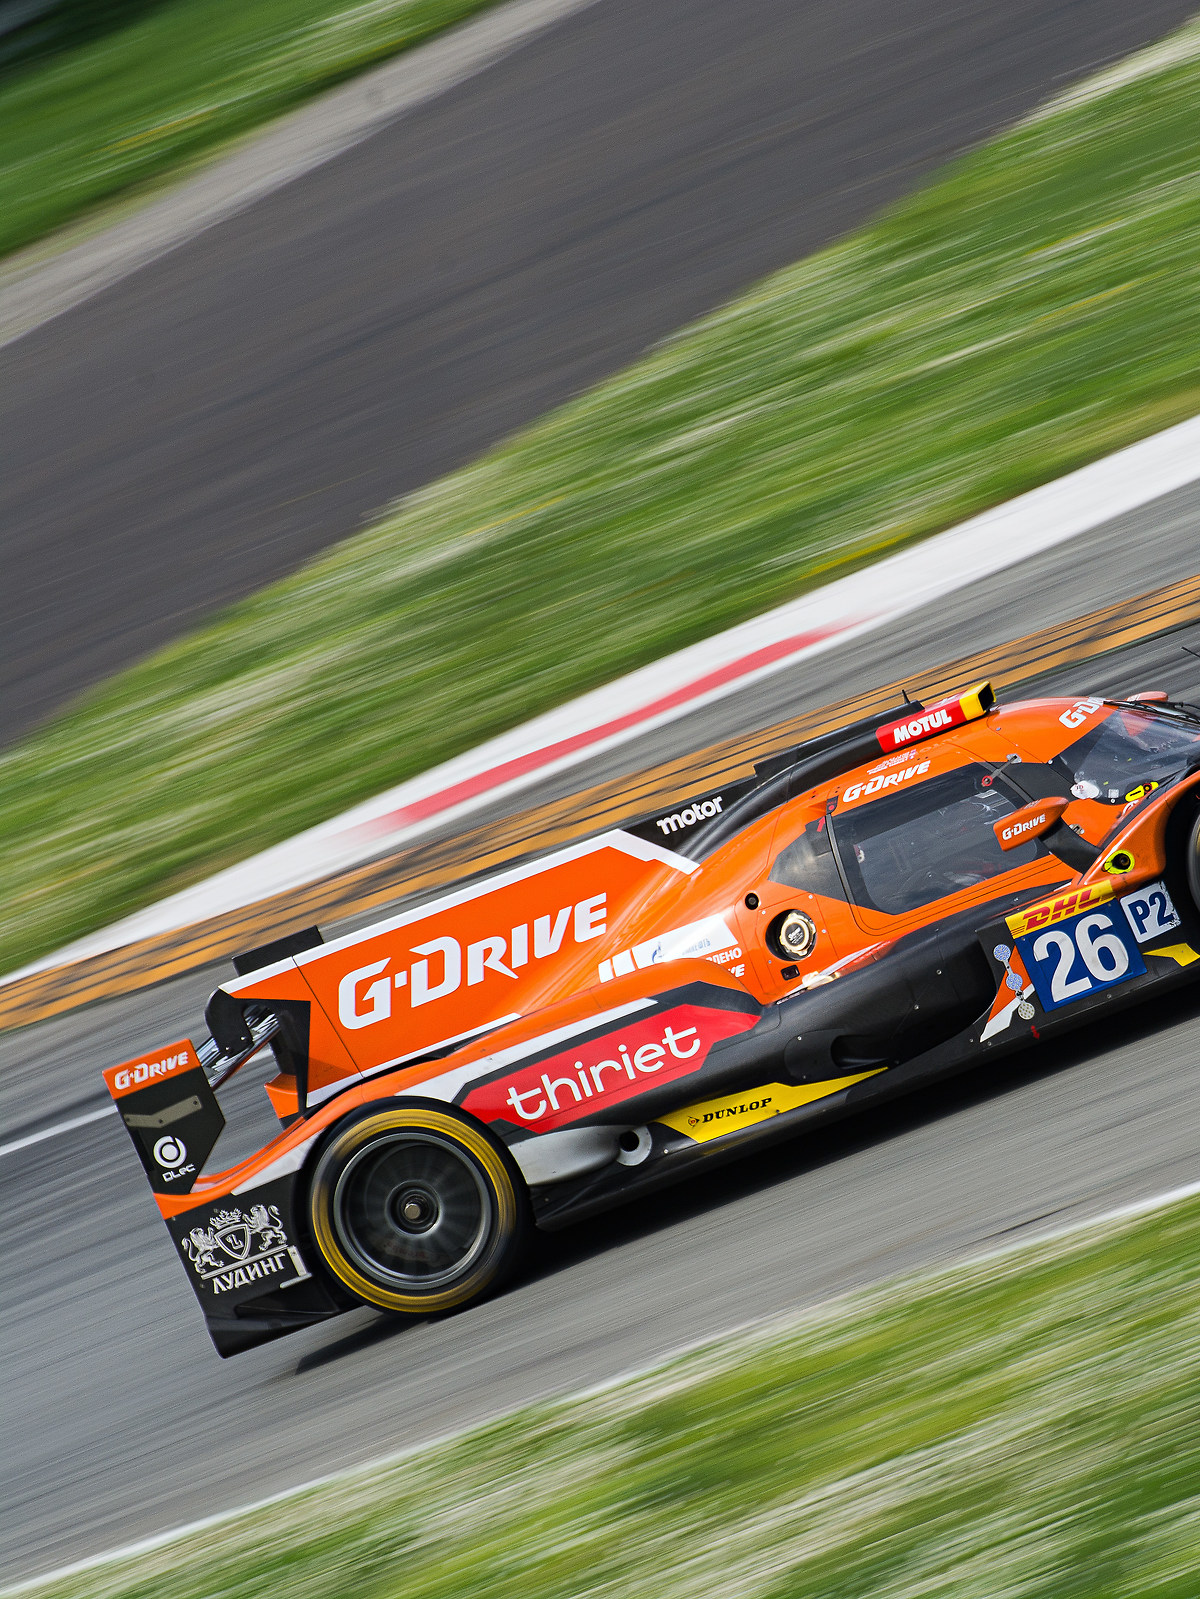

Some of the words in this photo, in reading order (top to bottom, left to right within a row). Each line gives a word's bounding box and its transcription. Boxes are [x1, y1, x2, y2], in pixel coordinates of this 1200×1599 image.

[893, 708, 953, 744] MOTUL
[842, 760, 932, 803] G-DRIVE
[656, 795, 723, 835] motor
[1002, 813, 1046, 841] G-DRIVE
[1022, 889, 1104, 931] DHL
[1127, 891, 1174, 936] P2
[338, 892, 607, 1031] G-DRIVE
[1033, 913, 1130, 1003] 26
[114, 1051, 189, 1091] G-DRIVE
[506, 1026, 701, 1121] thiriet
[701, 1097, 773, 1124] DUNLOP
[212, 1252, 287, 1295] ЛУДИНГ
